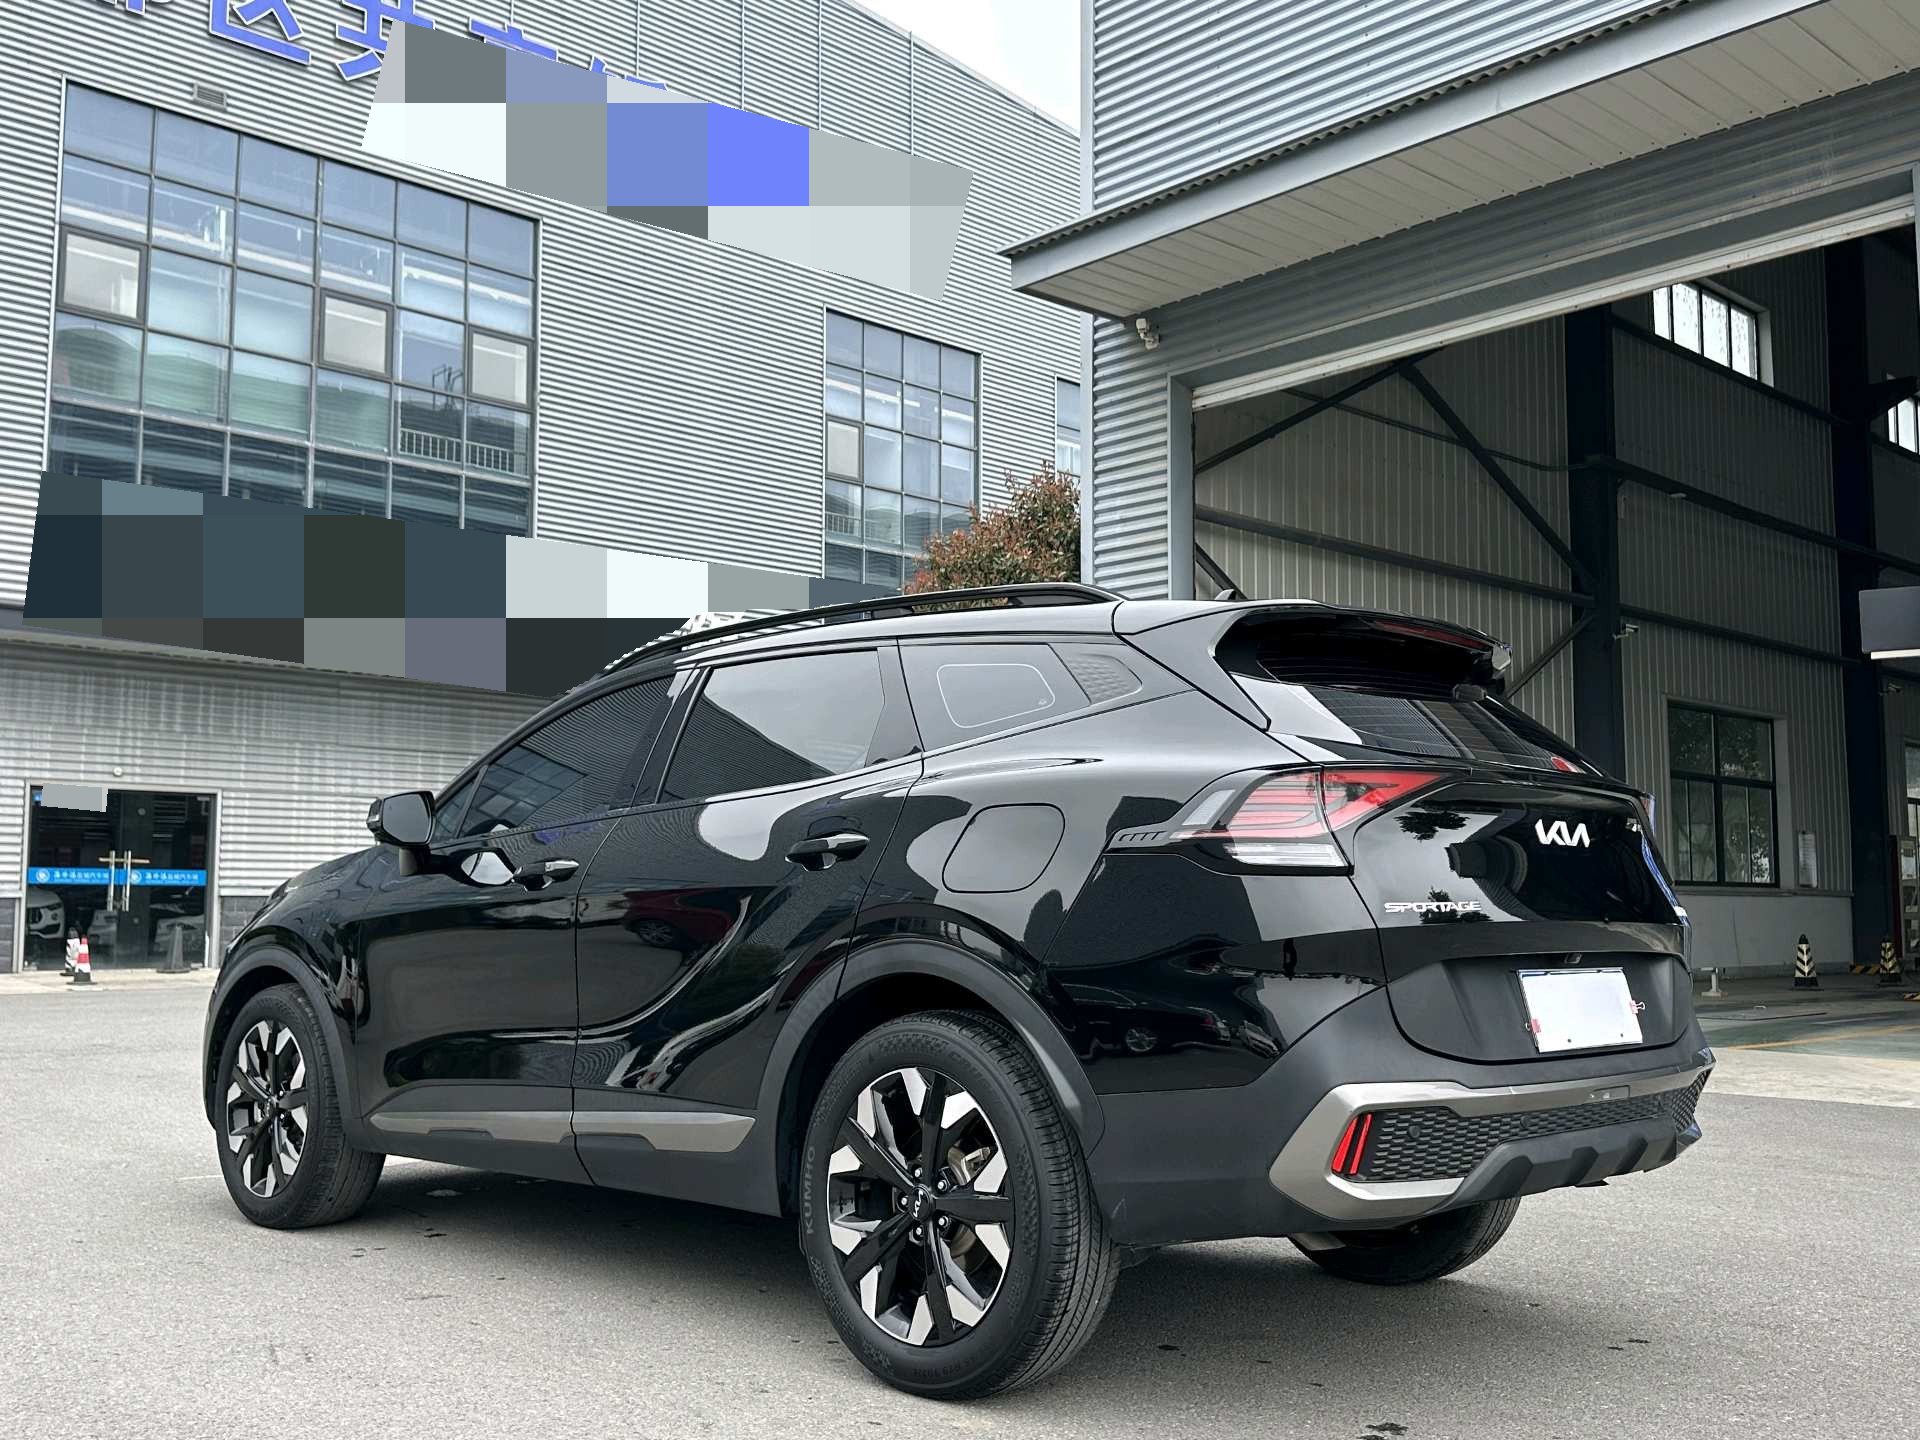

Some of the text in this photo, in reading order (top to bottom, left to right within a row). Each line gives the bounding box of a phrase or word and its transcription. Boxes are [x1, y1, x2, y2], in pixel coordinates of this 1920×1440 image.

[1534, 818, 1591, 848] KIA
[1383, 900, 1482, 913] SPORTAGE
[803, 1146, 816, 1235] KUMHO
